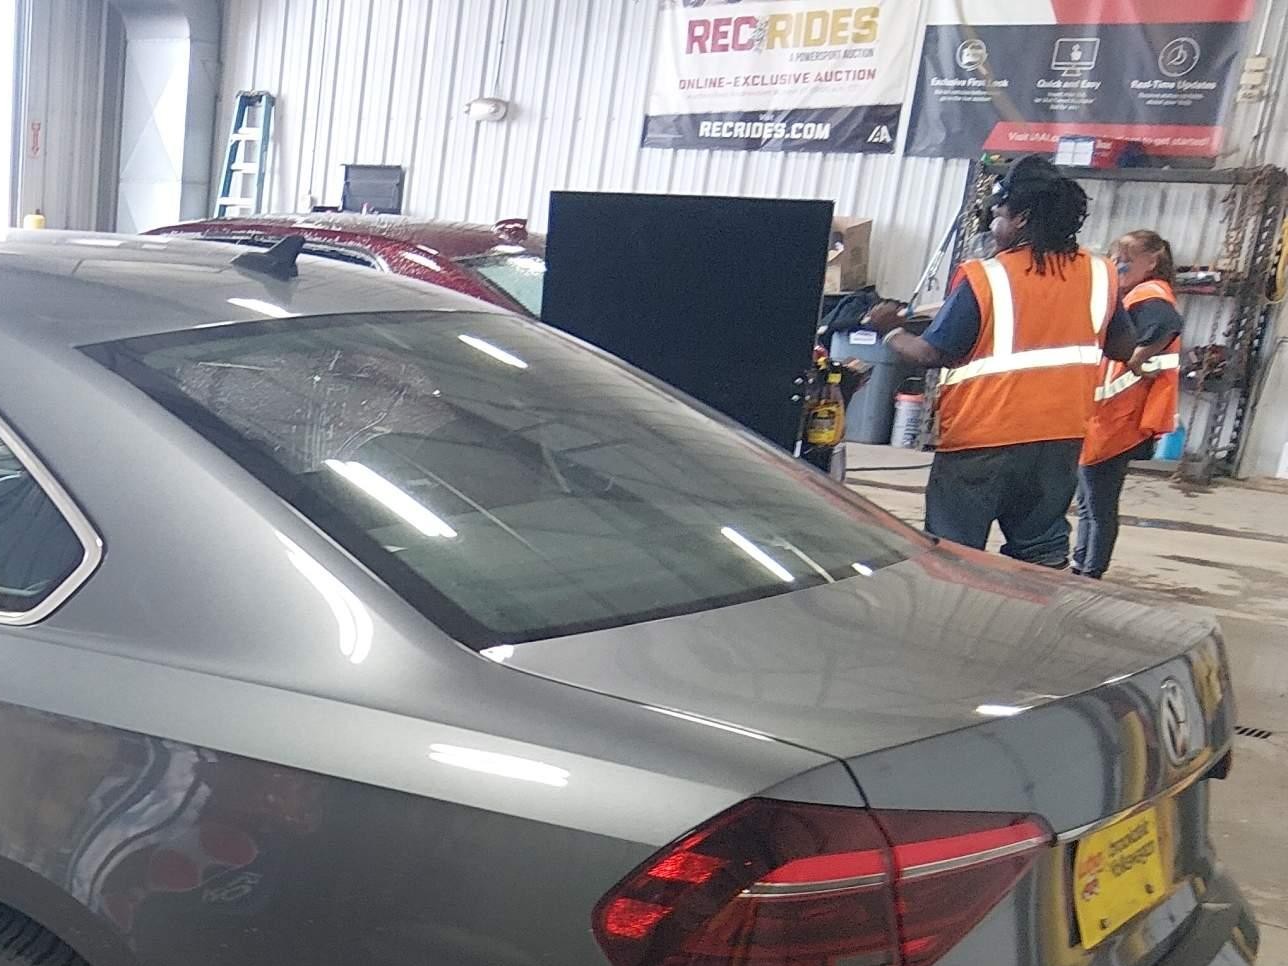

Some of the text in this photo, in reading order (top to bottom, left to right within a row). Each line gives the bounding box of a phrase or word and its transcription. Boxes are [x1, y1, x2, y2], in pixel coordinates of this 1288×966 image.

[685, 6, 880, 55] REC RIDES
[842, 48, 874, 60] AUCTION
[678, 68, 877, 90] ONLINE-EXCLUSIVE AUCTION
[1176, 80, 1217, 91] Updates
[699, 121, 831, 141] RECRIDES.COM
